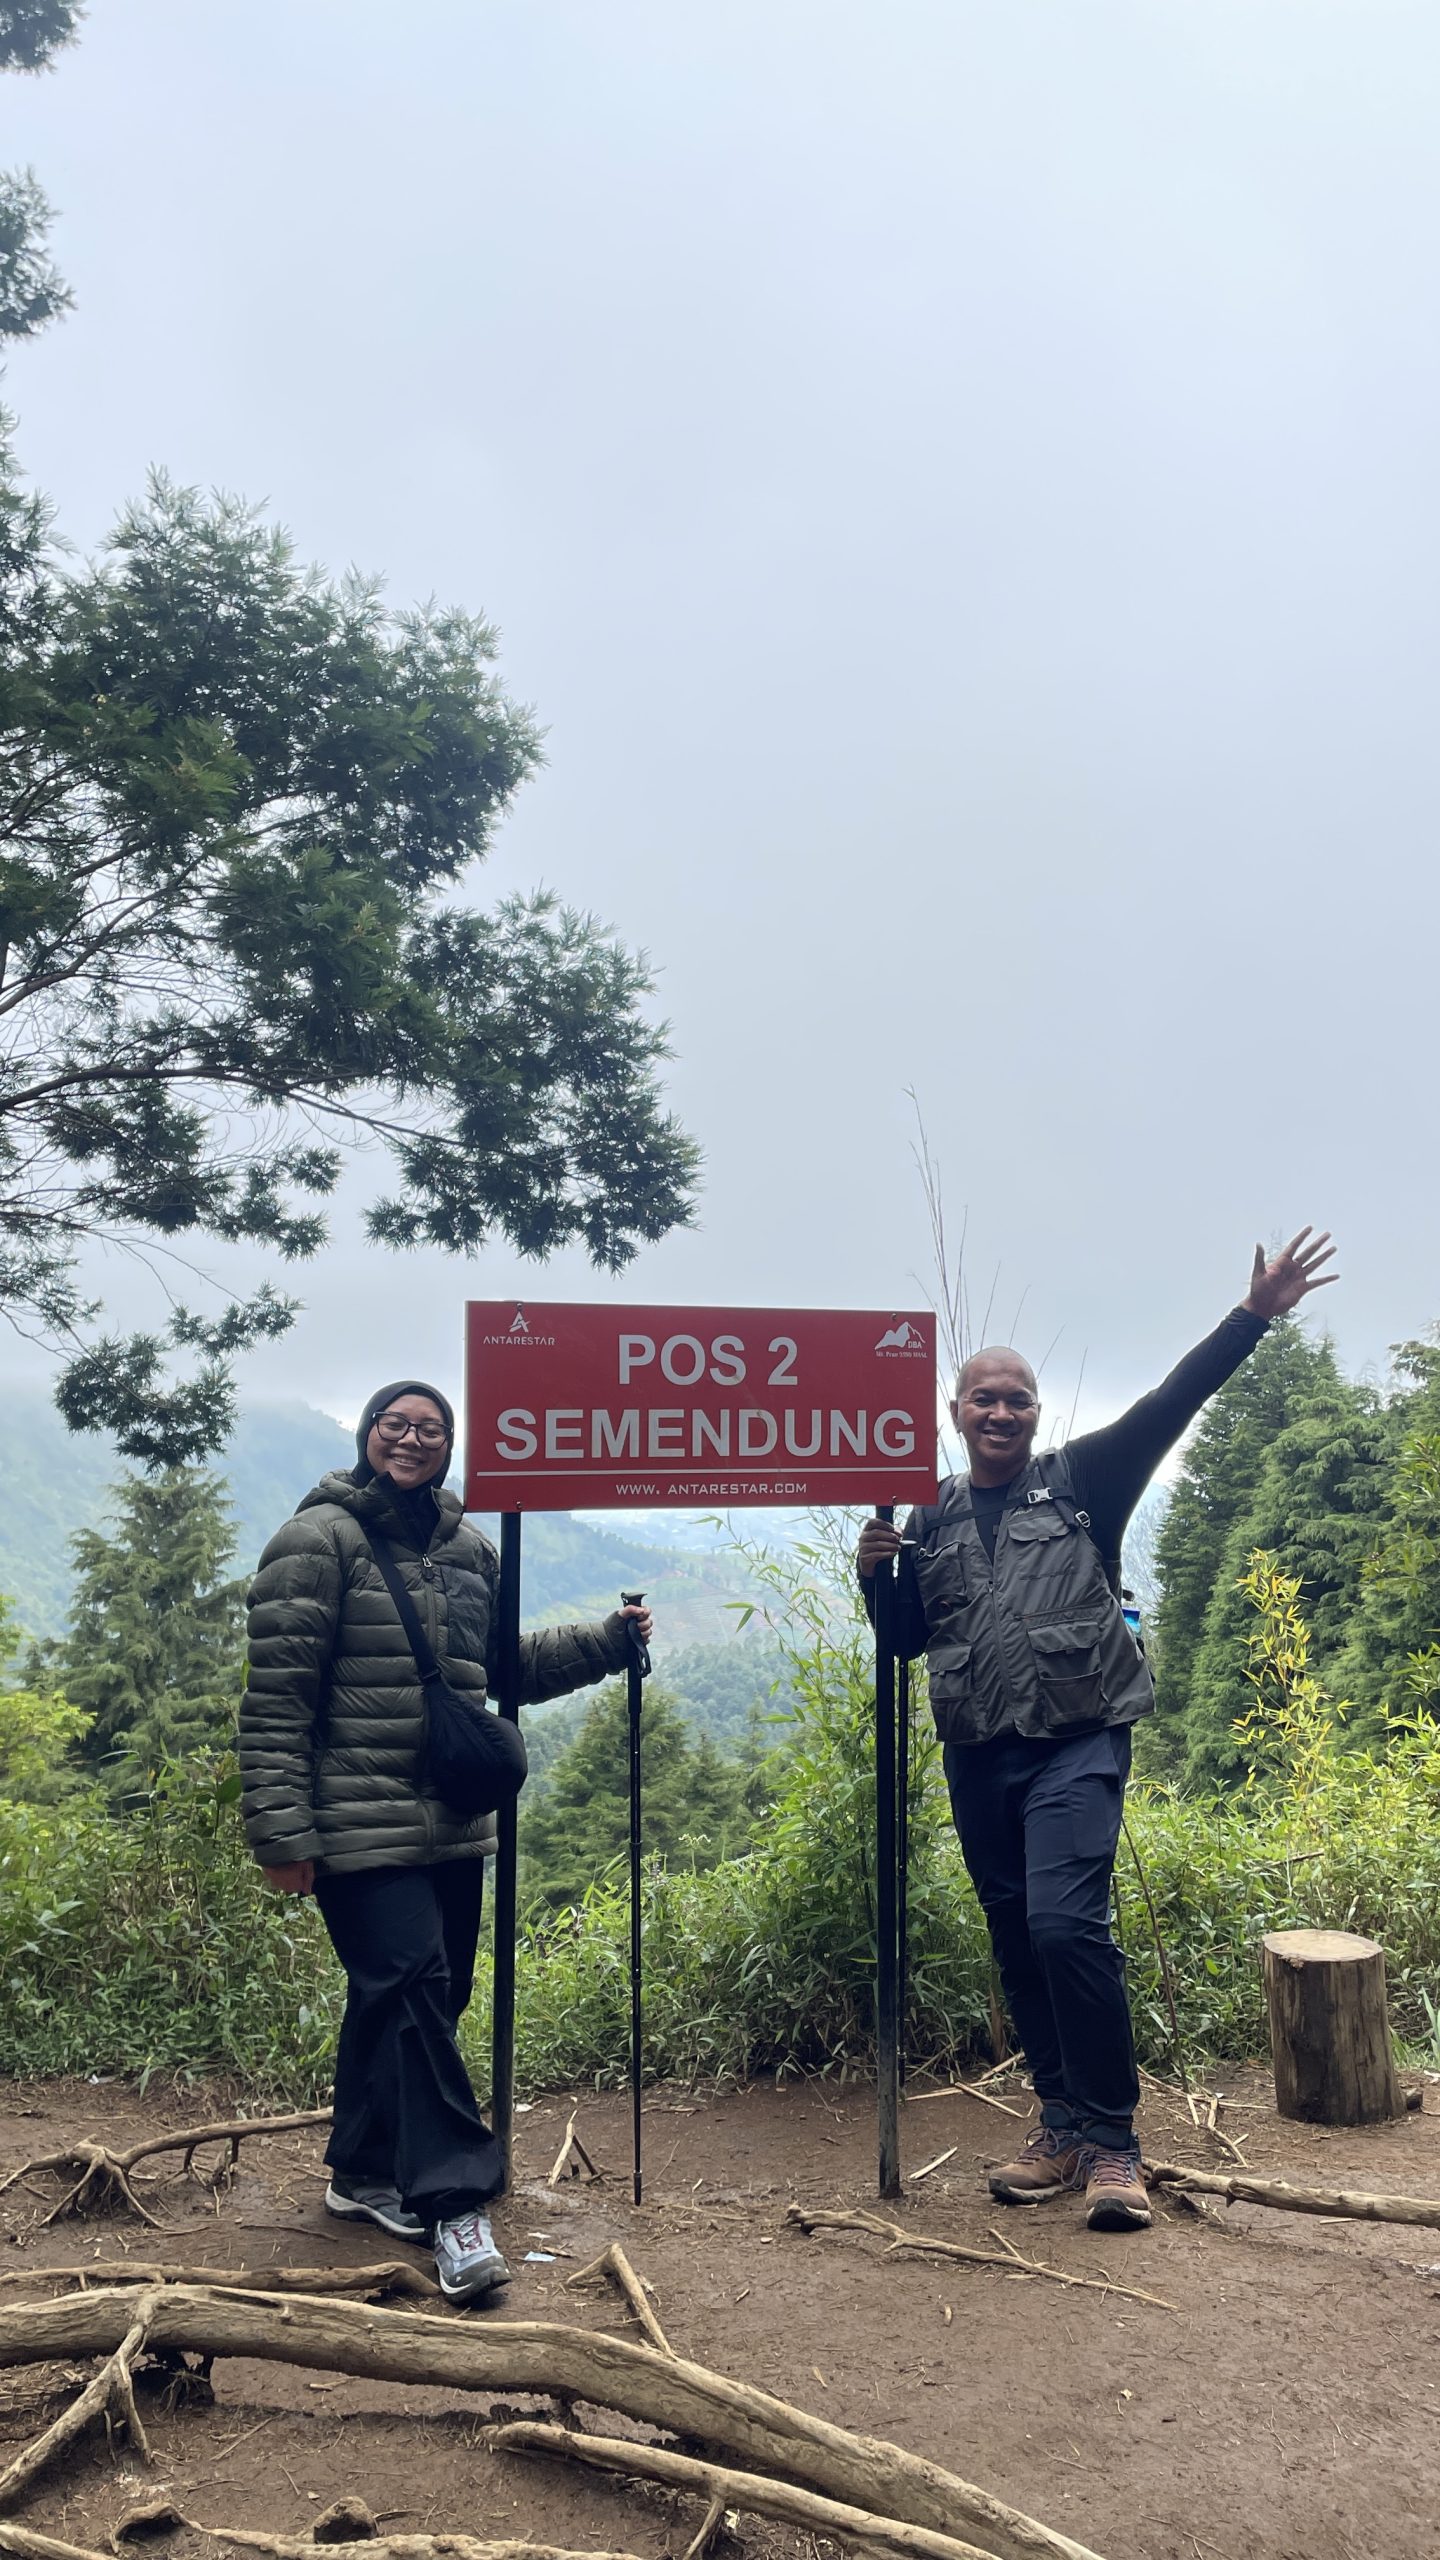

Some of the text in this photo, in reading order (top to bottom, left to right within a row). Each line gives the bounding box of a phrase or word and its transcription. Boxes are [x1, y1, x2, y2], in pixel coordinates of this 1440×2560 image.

[483, 1336, 555, 1346] ANTARESTAR
[618, 1334, 798, 1386] POS 2
[495, 1408, 916, 1461] SEMENDUNG
[615, 1483, 807, 1495] WWW. ANTARESTAR.COM
